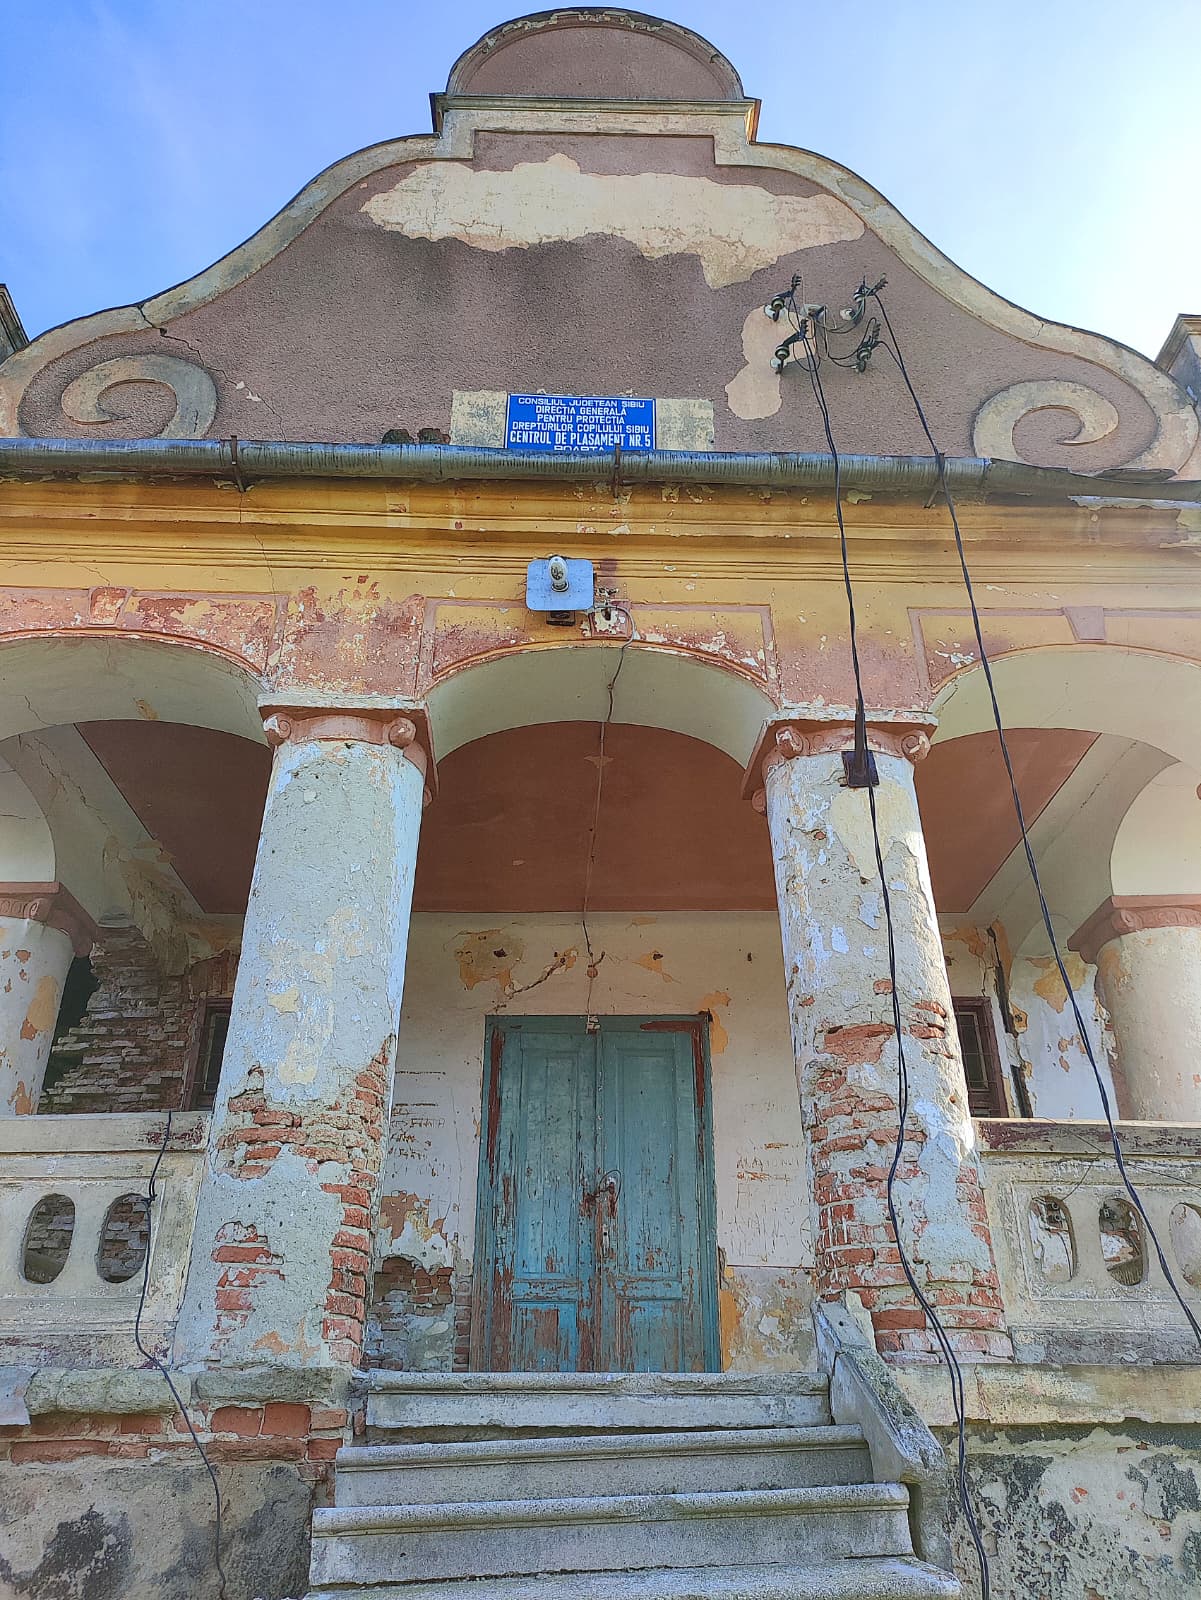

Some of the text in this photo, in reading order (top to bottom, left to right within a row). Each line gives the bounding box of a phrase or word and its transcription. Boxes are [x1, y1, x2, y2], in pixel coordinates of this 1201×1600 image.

[518, 397, 566, 406] CONSILIUL
[537, 414, 573, 423] PENTRU
[512, 421, 650, 434] DREPTURILOR COPILULUI SIBIU
[510, 430, 651, 447] CENTRUL DE PLASAMENT NR. 5
